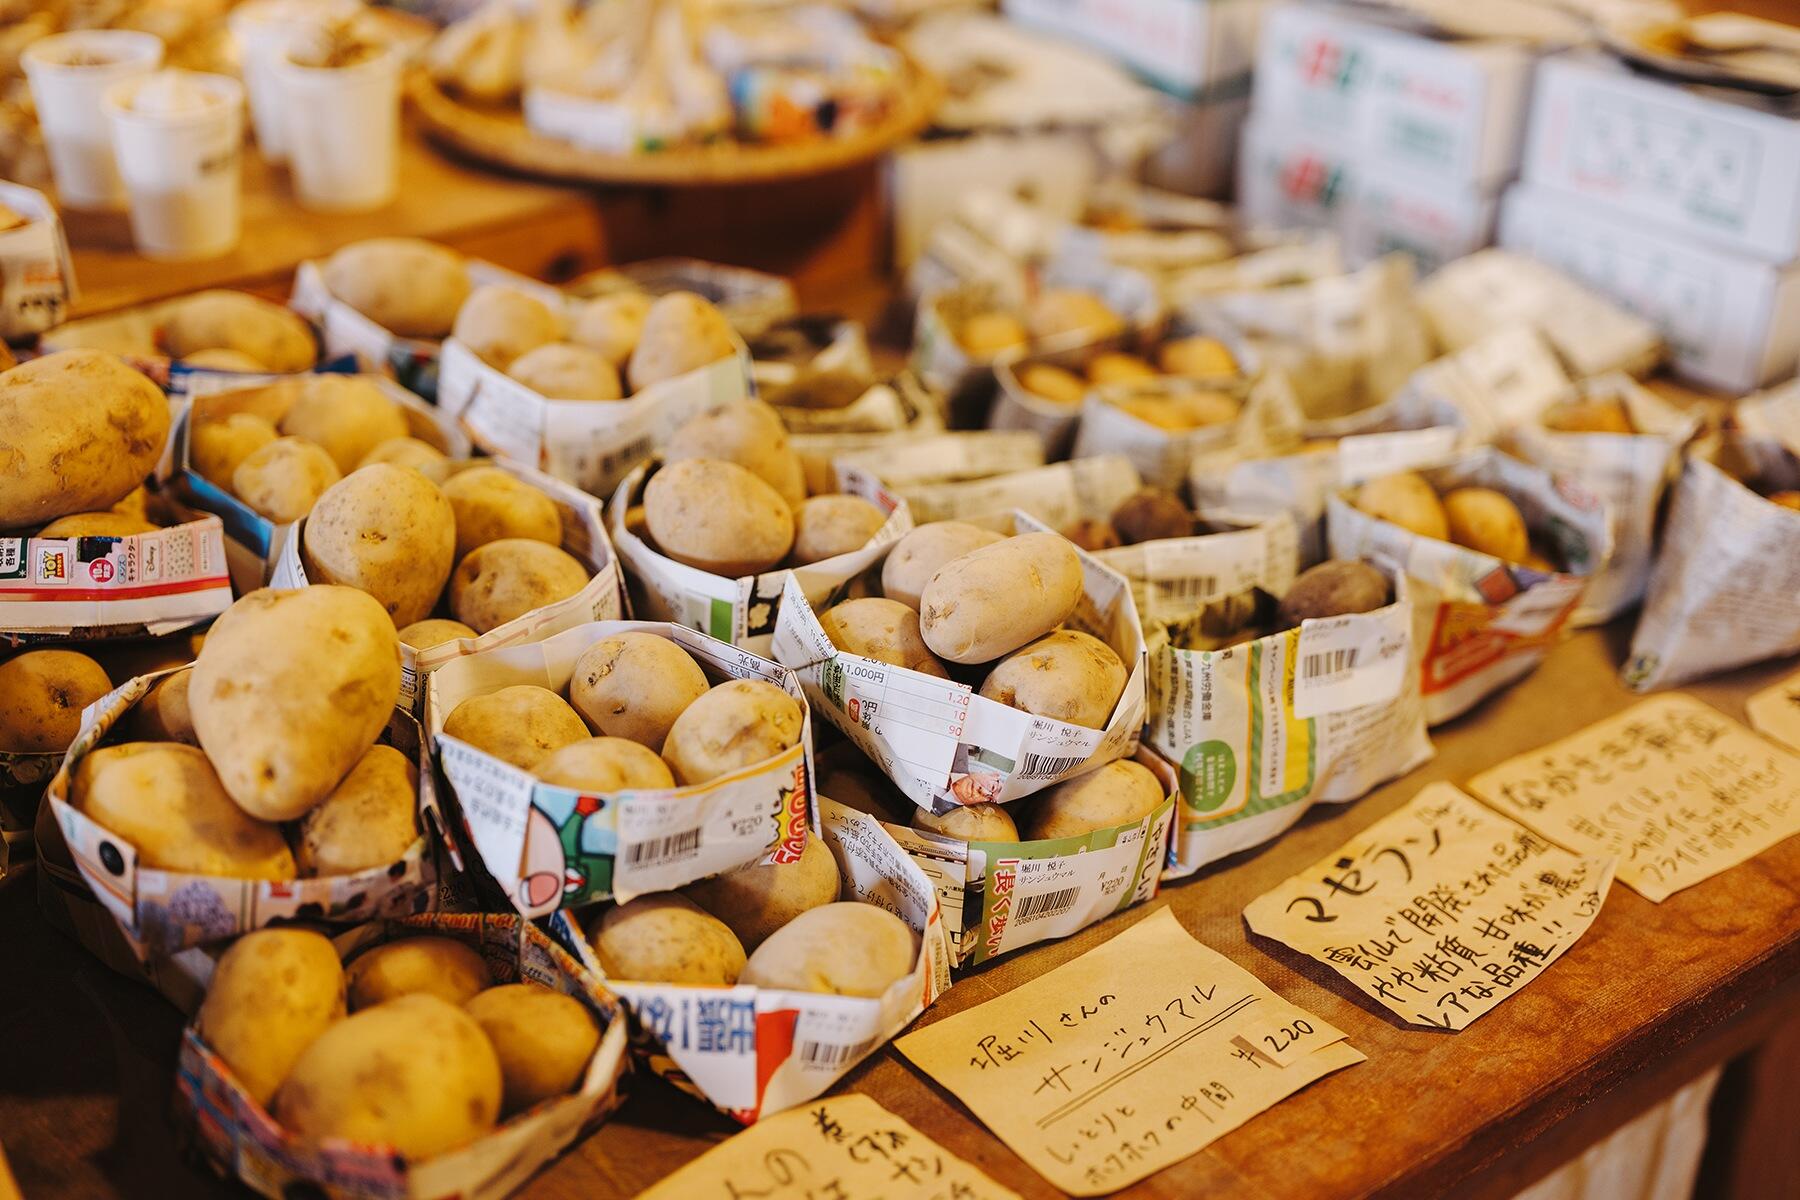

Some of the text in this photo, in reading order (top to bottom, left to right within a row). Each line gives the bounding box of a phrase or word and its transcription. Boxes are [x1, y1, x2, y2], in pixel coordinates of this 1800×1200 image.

[42, 550, 57, 580] TOY
[56, 553, 65, 577] STORY
[127, 538, 135, 582] キャラクター
[1028, 730, 1092, 748] サンジュウマル
[1018, 868, 1077, 886] サンジュウマル
[1134, 821, 1166, 902] やさしい
[1286, 828, 1442, 924] マゼラン
[1033, 984, 1218, 1095] サンジュウマル
